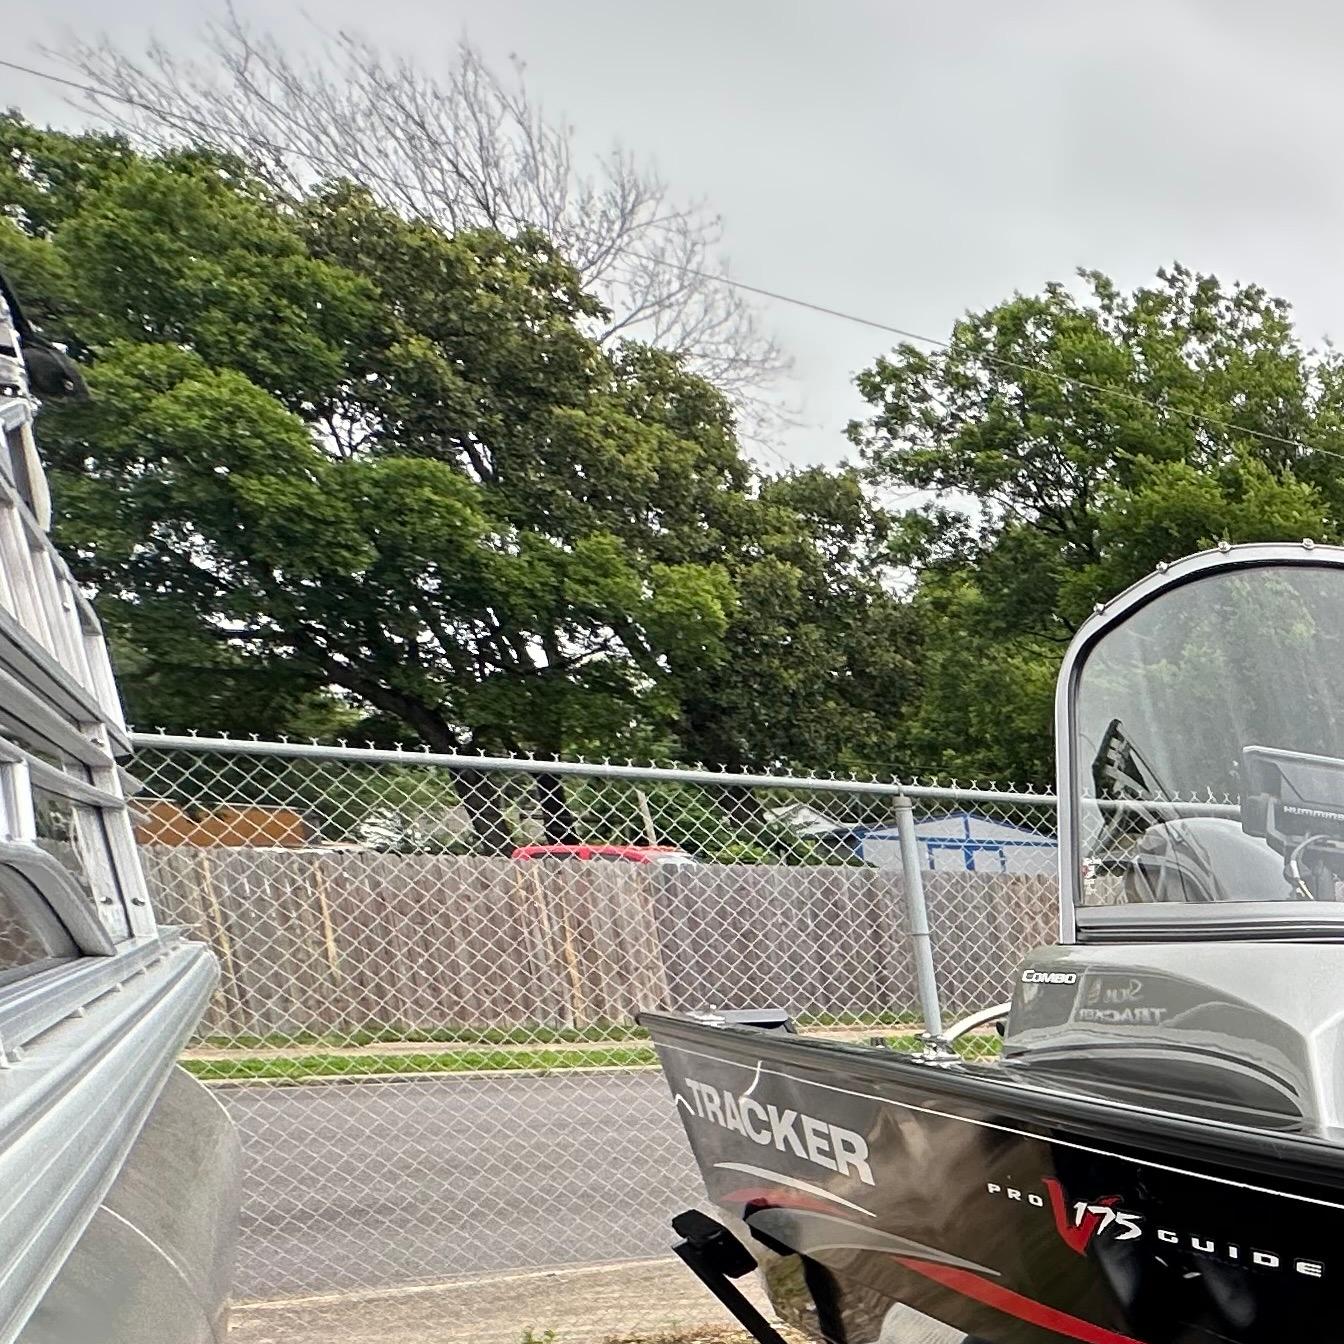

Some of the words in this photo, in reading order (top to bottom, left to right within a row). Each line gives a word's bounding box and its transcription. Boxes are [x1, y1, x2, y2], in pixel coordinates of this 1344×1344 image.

[685, 1077, 876, 1186] TRACKER
[988, 1183, 1043, 1207] PRO
[1157, 1229, 1322, 1278] GUIDE
